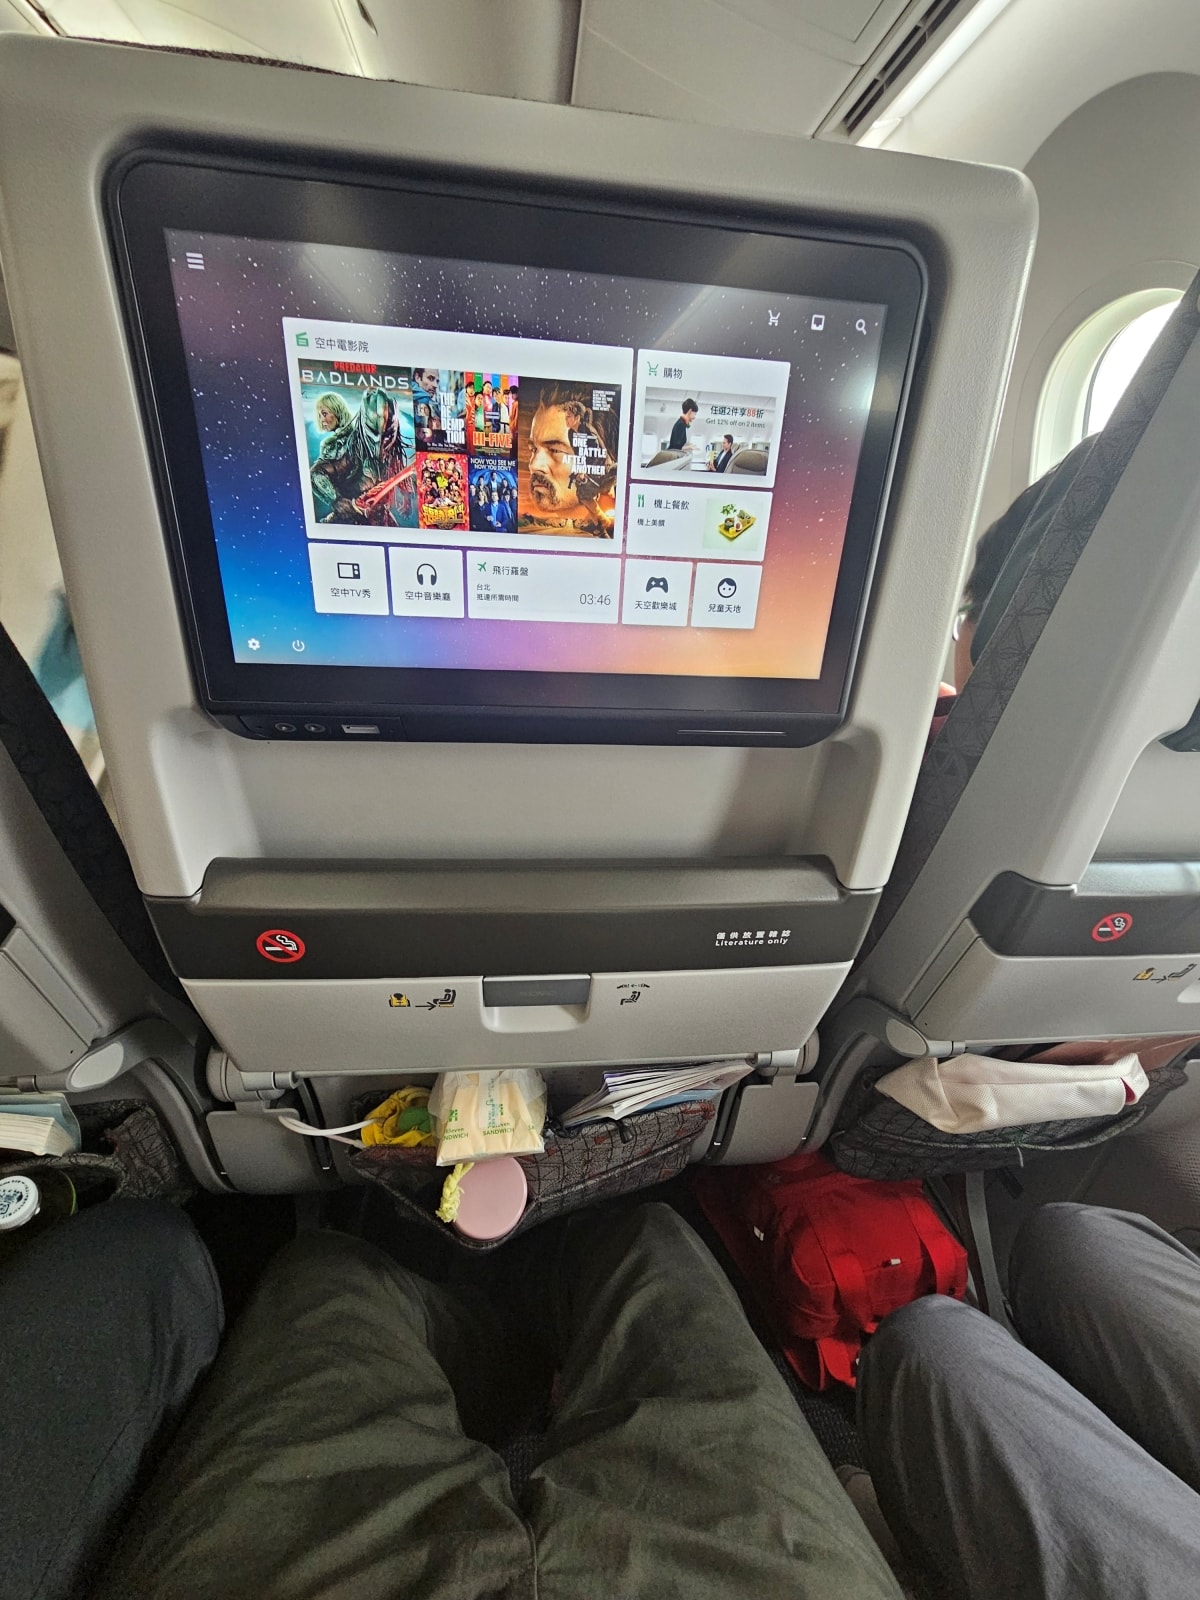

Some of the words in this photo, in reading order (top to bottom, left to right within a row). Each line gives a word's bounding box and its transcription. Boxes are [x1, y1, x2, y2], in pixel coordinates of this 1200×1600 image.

[314, 337, 370, 353] 空中電影院
[663, 367, 683, 379] 購物
[301, 369, 409, 390] BADLANDS
[439, 392, 455, 406] THE
[710, 405, 765, 419] 任選2件享88折
[751, 421, 766, 429] items
[445, 430, 466, 444] TION
[472, 431, 513, 449] HI-FIVE
[572, 437, 588, 448] ONE
[578, 447, 607, 458] BATTLE
[562, 454, 587, 465] AFTER
[571, 464, 606, 476] ANOTHER
[653, 499, 690, 511] 機上餐飲
[492, 565, 529, 577] 飛行羅盤
[330, 587, 372, 599] 空中TV秀
[476, 583, 491, 592] 台北
[404, 590, 452, 602] 空中音樂廳
[476, 593, 520, 603] 抵達所需時間
[579, 593, 612, 606] 03:46
[634, 600, 678, 611] 天空歡樂城
[707, 603, 742, 614] 兒童天地
[715, 939, 764, 947] Literature
[767, 937, 788, 945] only
[482, 1127, 515, 1137] SANDWICH
